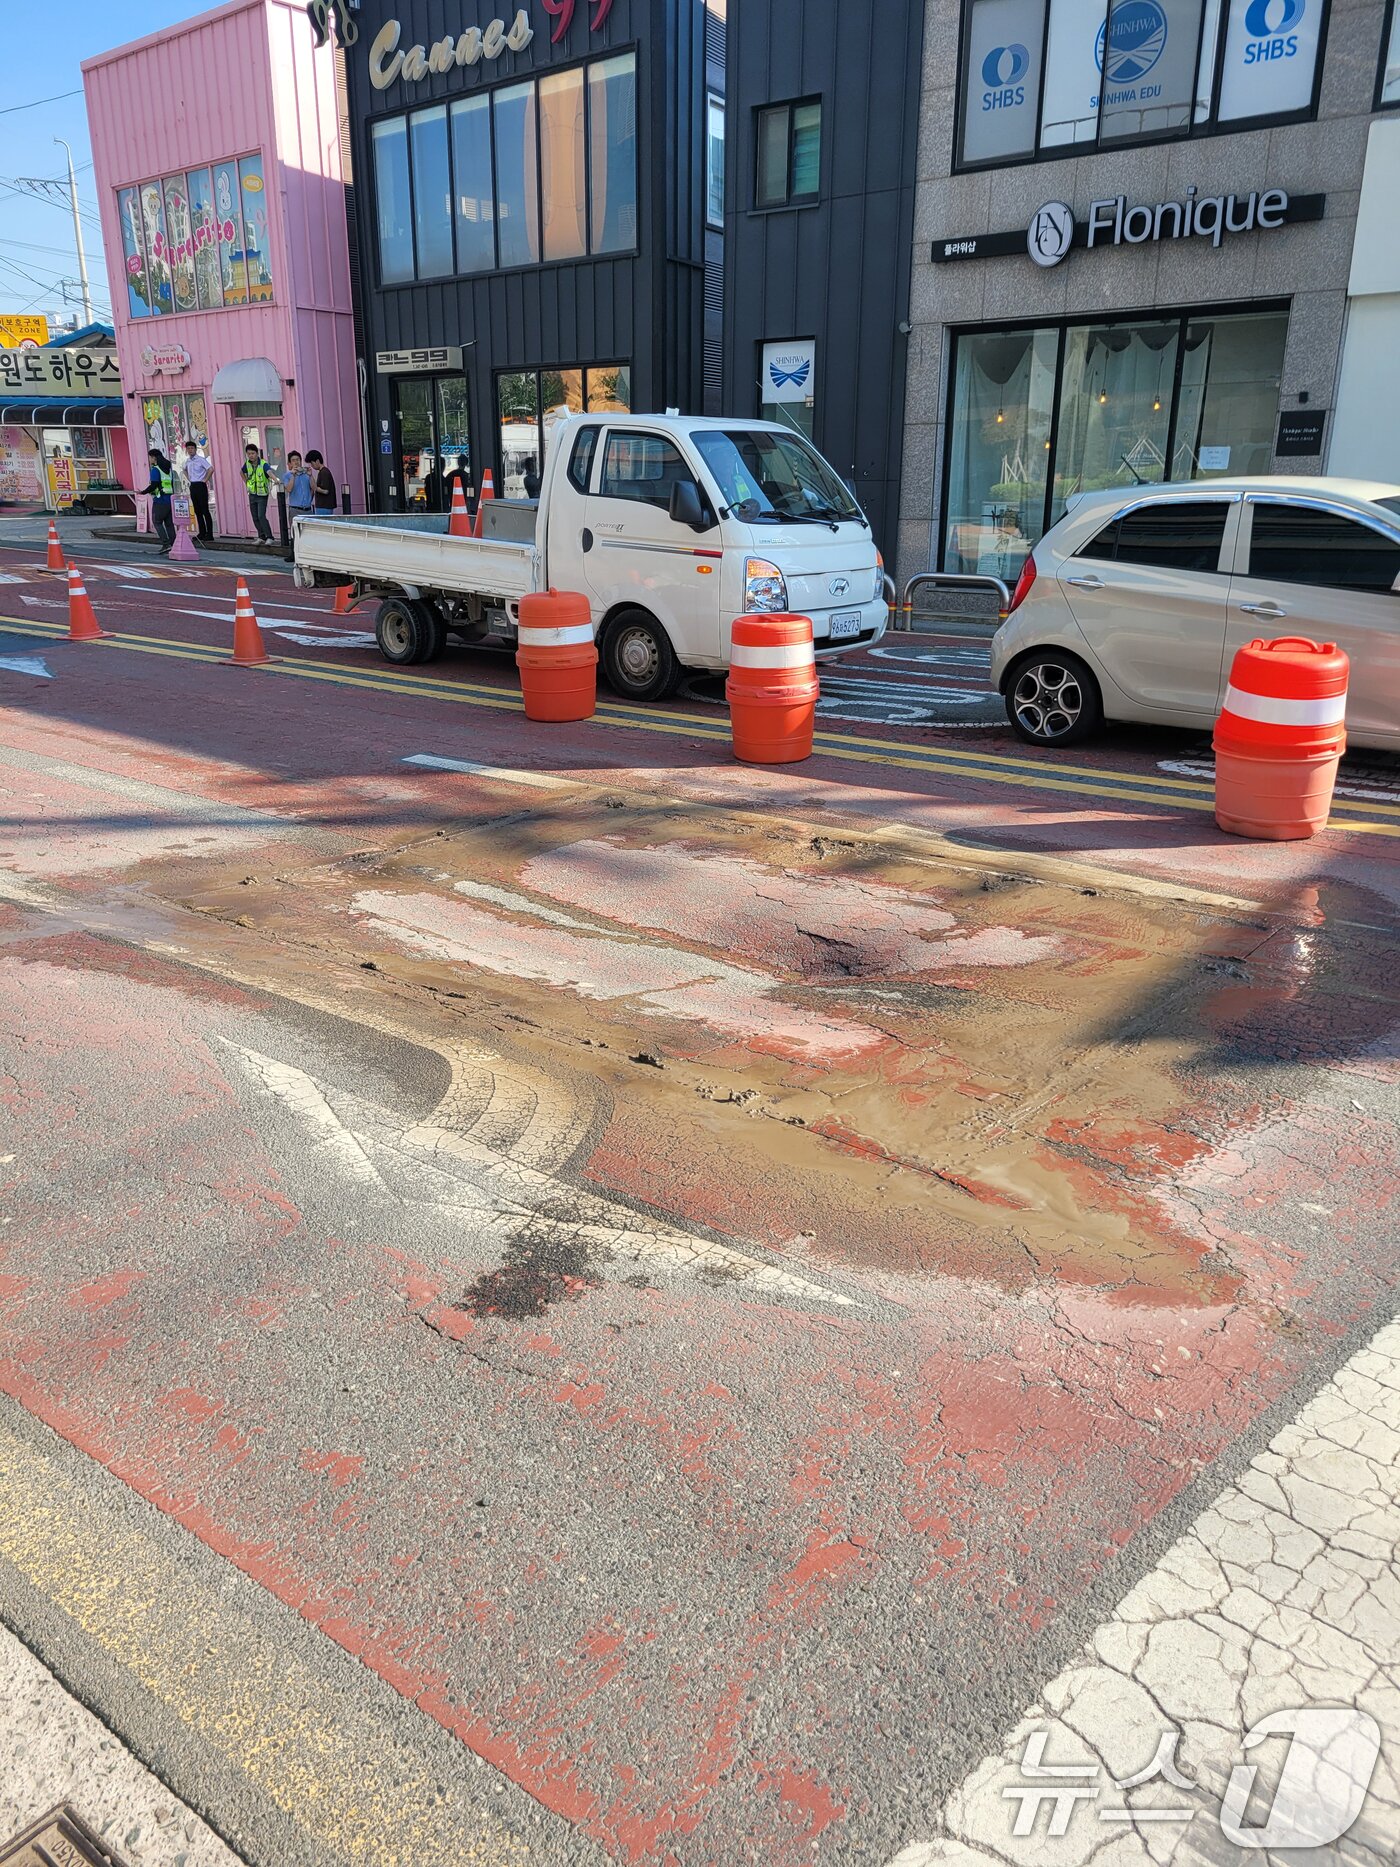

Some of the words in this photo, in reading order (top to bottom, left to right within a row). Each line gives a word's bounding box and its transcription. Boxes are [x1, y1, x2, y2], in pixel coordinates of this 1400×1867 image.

[1110, 16, 1158, 37] HINHWA
[369, 9, 534, 90] Cannes
[1243, 35, 1299, 65] SHBS
[982, 86, 1026, 112] SHBS
[1140, 84, 1162, 99] EDU
[1087, 185, 1289, 249] Flonique
[944, 240, 977, 256] 플라워샵
[153, 353, 185, 366] Sararito
[775, 356, 805, 365] SHINHWA
